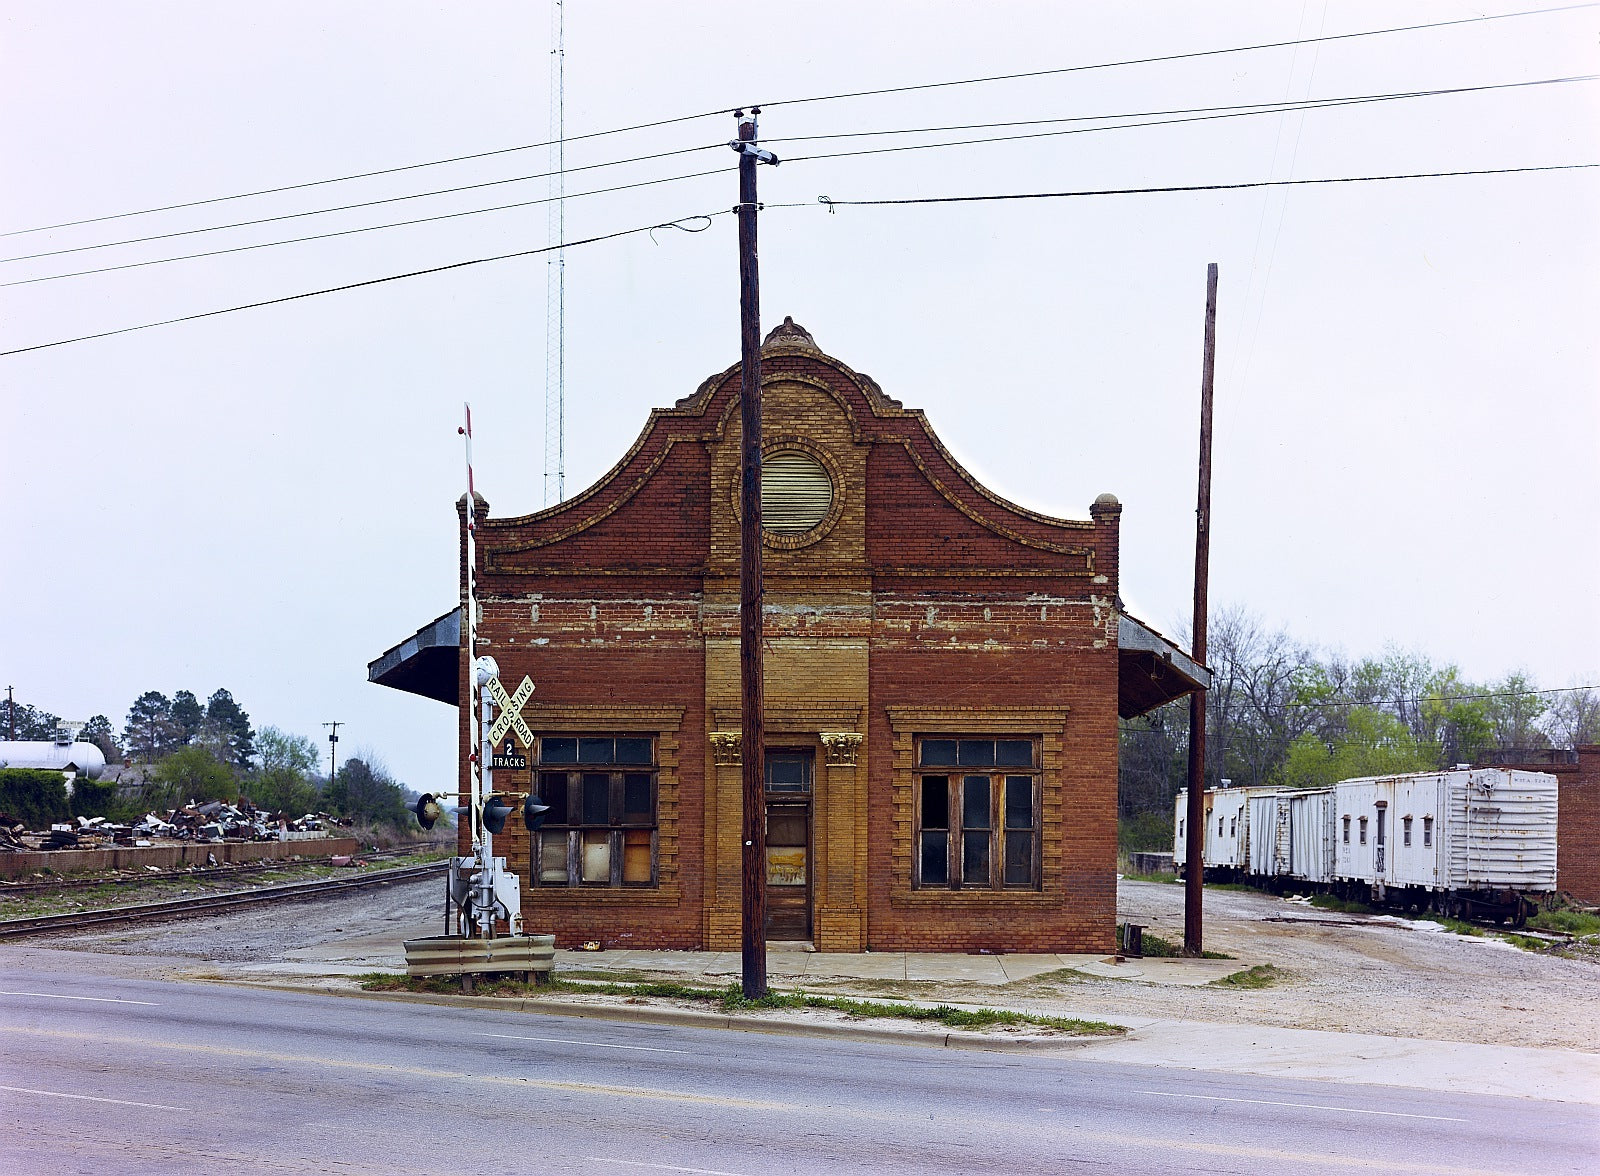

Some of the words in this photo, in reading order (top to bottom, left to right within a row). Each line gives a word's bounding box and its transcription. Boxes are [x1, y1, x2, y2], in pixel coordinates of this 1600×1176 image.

[488, 677, 506, 707] RAIL
[514, 718, 532, 745] ROAD
[492, 682, 532, 741] CROSSING
[493, 757, 525, 767] TRACKS
[506, 743, 513, 756] 2
